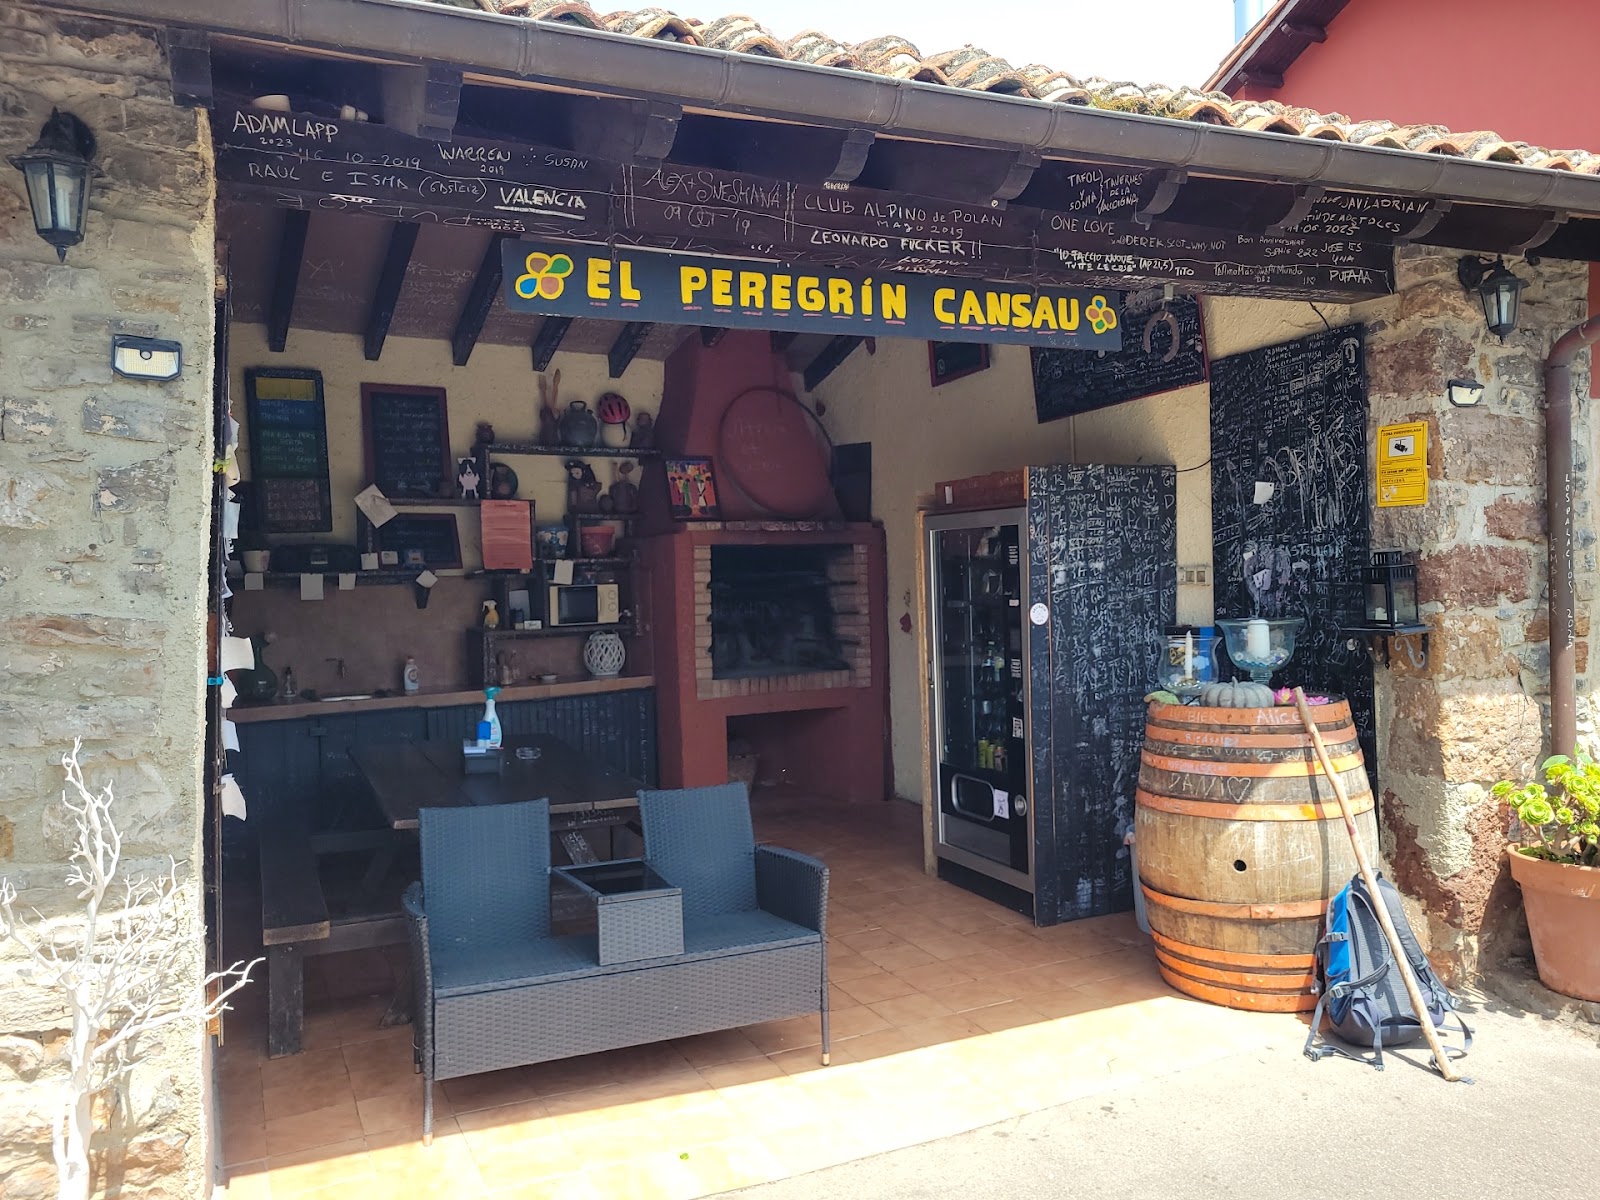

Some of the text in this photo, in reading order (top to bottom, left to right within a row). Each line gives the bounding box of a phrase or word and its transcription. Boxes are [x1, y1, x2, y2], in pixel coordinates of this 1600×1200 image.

[260, 137, 293, 147] 2023
[437, 143, 511, 164] WARREN
[544, 154, 589, 170] SUSAN
[480, 165, 504, 175] 2019
[500, 187, 587, 209] VALENCIA
[804, 194, 855, 214] CLUB
[864, 203, 926, 222] ALPINO
[950, 209, 1004, 227] POLAN
[930, 225, 964, 239] 2019
[1051, 215, 1115, 236] ONE LOVE
[810, 230, 889, 249] LEONARDO
[587, 257, 641, 301] EL
[933, 287, 1081, 331] CANSAU
[1256, 708, 1302, 725] Alice
